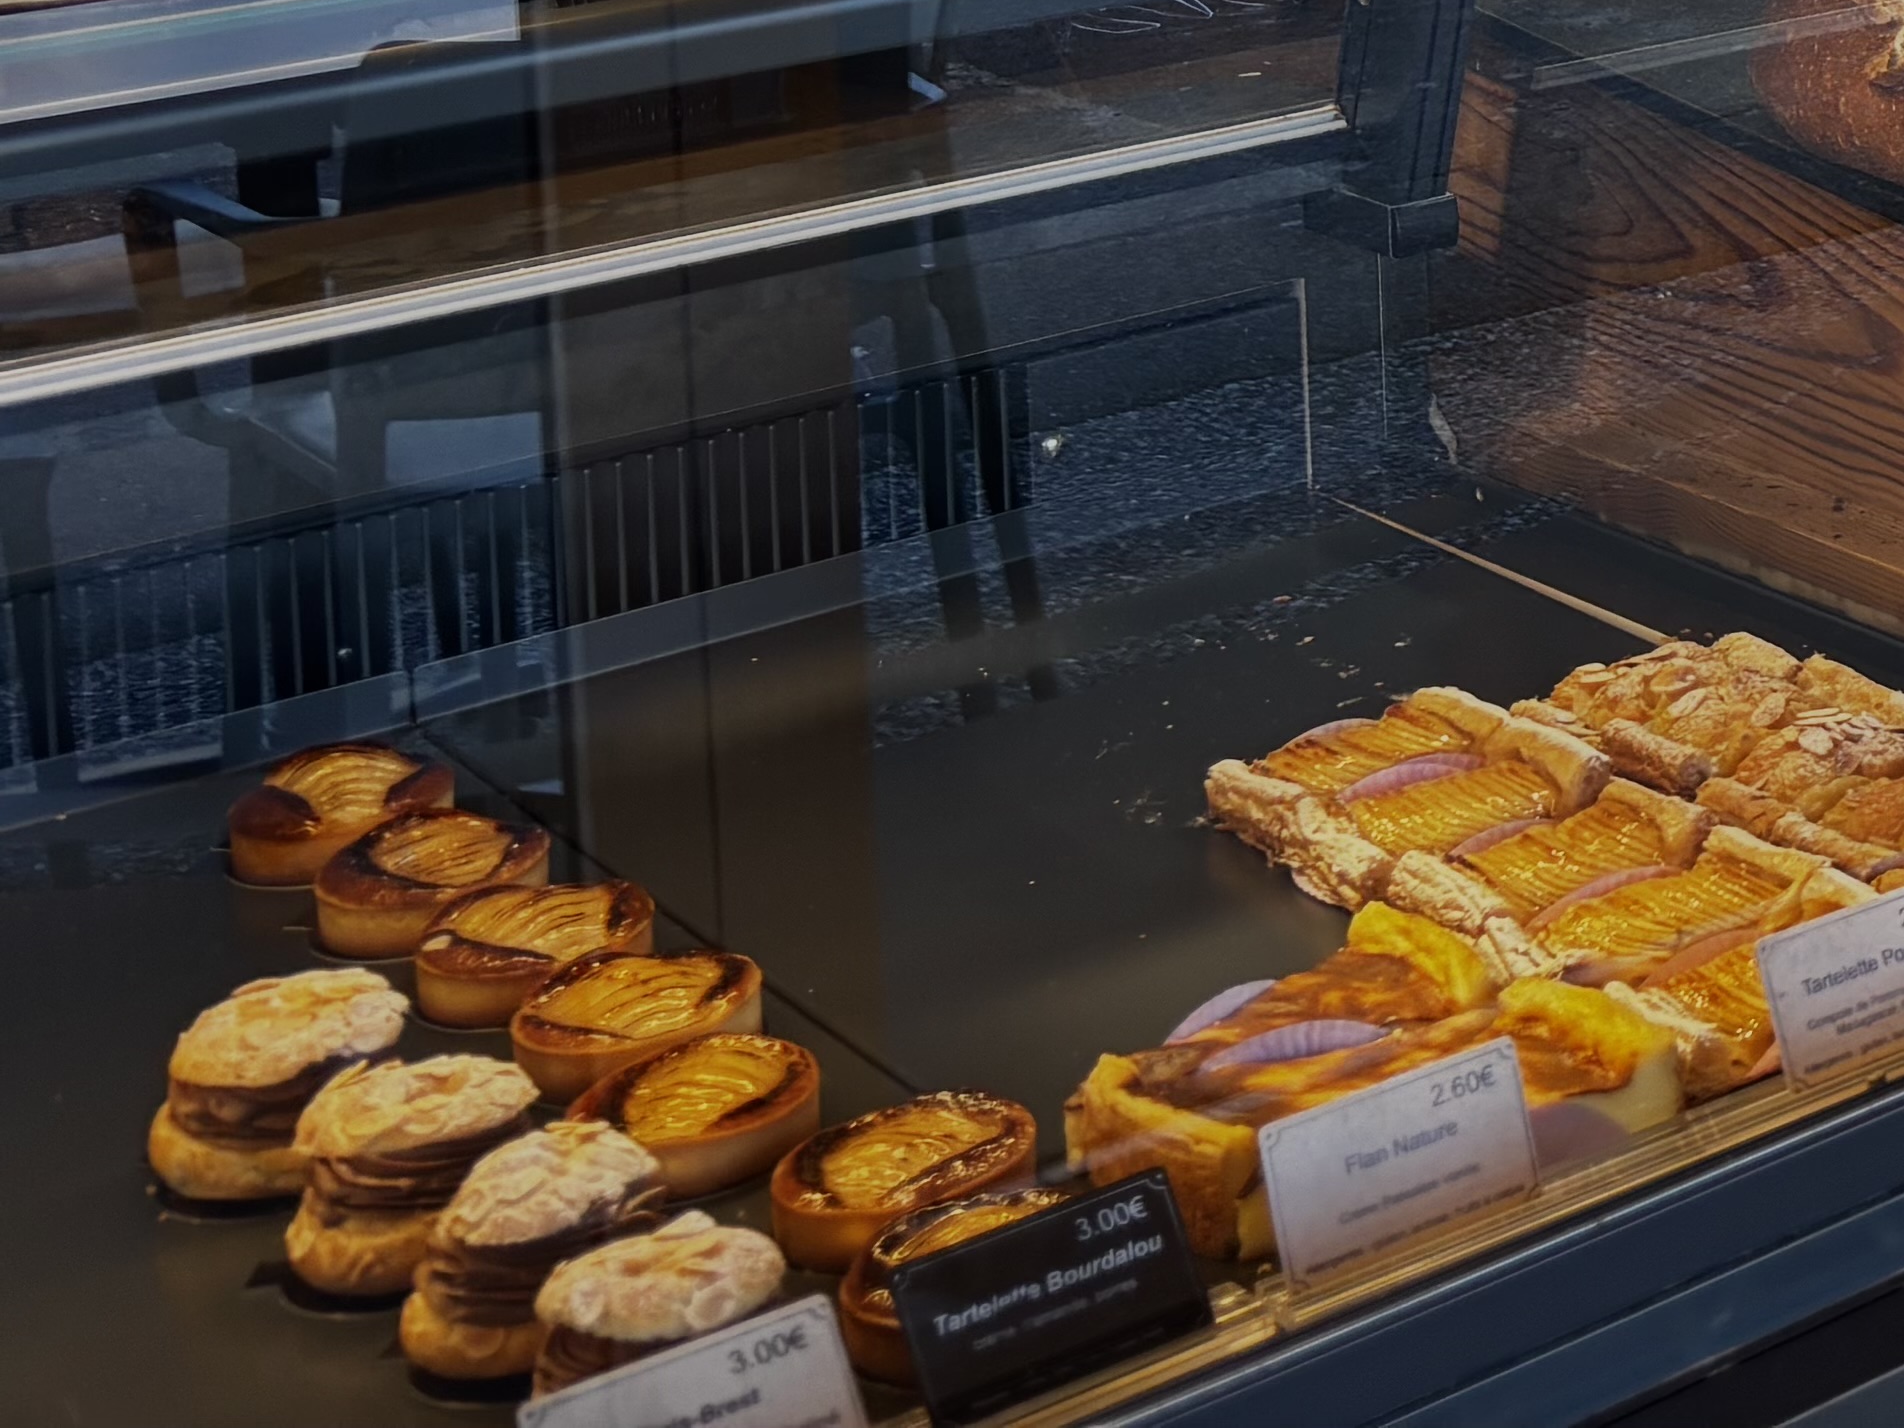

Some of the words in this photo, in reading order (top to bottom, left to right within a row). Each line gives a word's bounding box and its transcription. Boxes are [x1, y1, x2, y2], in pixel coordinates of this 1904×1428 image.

[1801, 955, 1879, 997] Tartelette
[1430, 1064, 1497, 1108] 2.60€
[1344, 1148, 1389, 1174] Flan
[1393, 1119, 1458, 1158] Nature
[1075, 1194, 1148, 1243] 3.00€
[1045, 1232, 1163, 1294] Bourdalou
[727, 1323, 806, 1376] 3.00€
